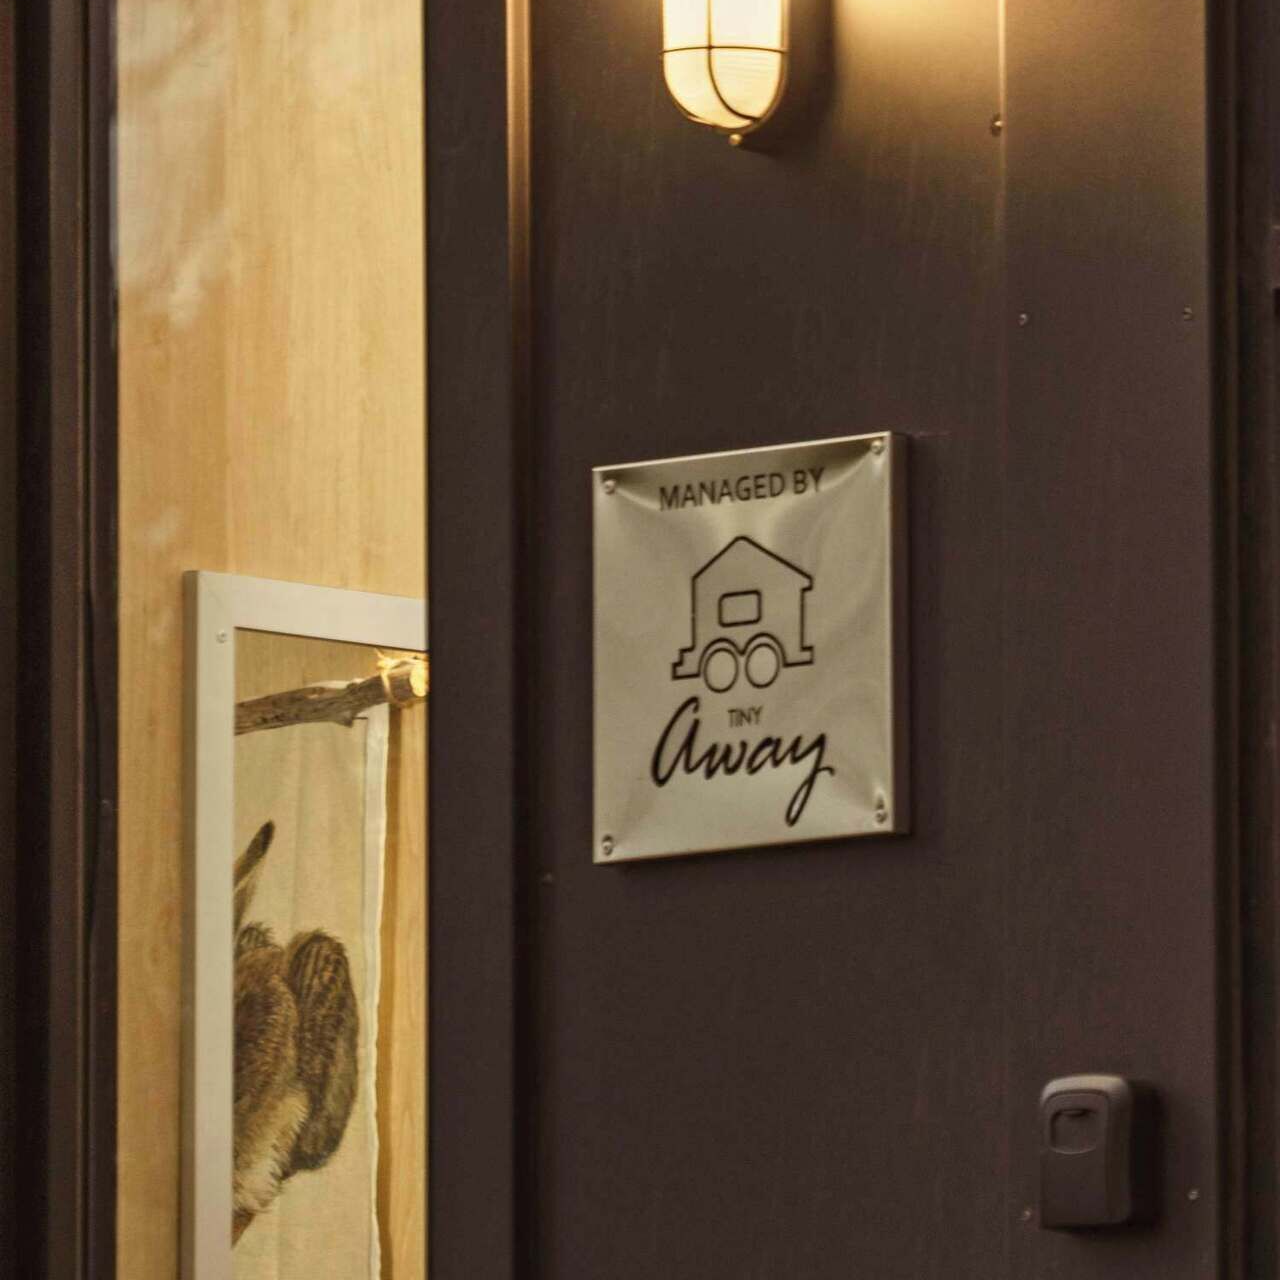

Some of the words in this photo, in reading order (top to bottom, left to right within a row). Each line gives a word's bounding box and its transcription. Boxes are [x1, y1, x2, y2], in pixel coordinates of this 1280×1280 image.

[659, 473, 785, 511] MANAGED
[794, 467, 826, 495] BY
[727, 706, 763, 727] TINY
